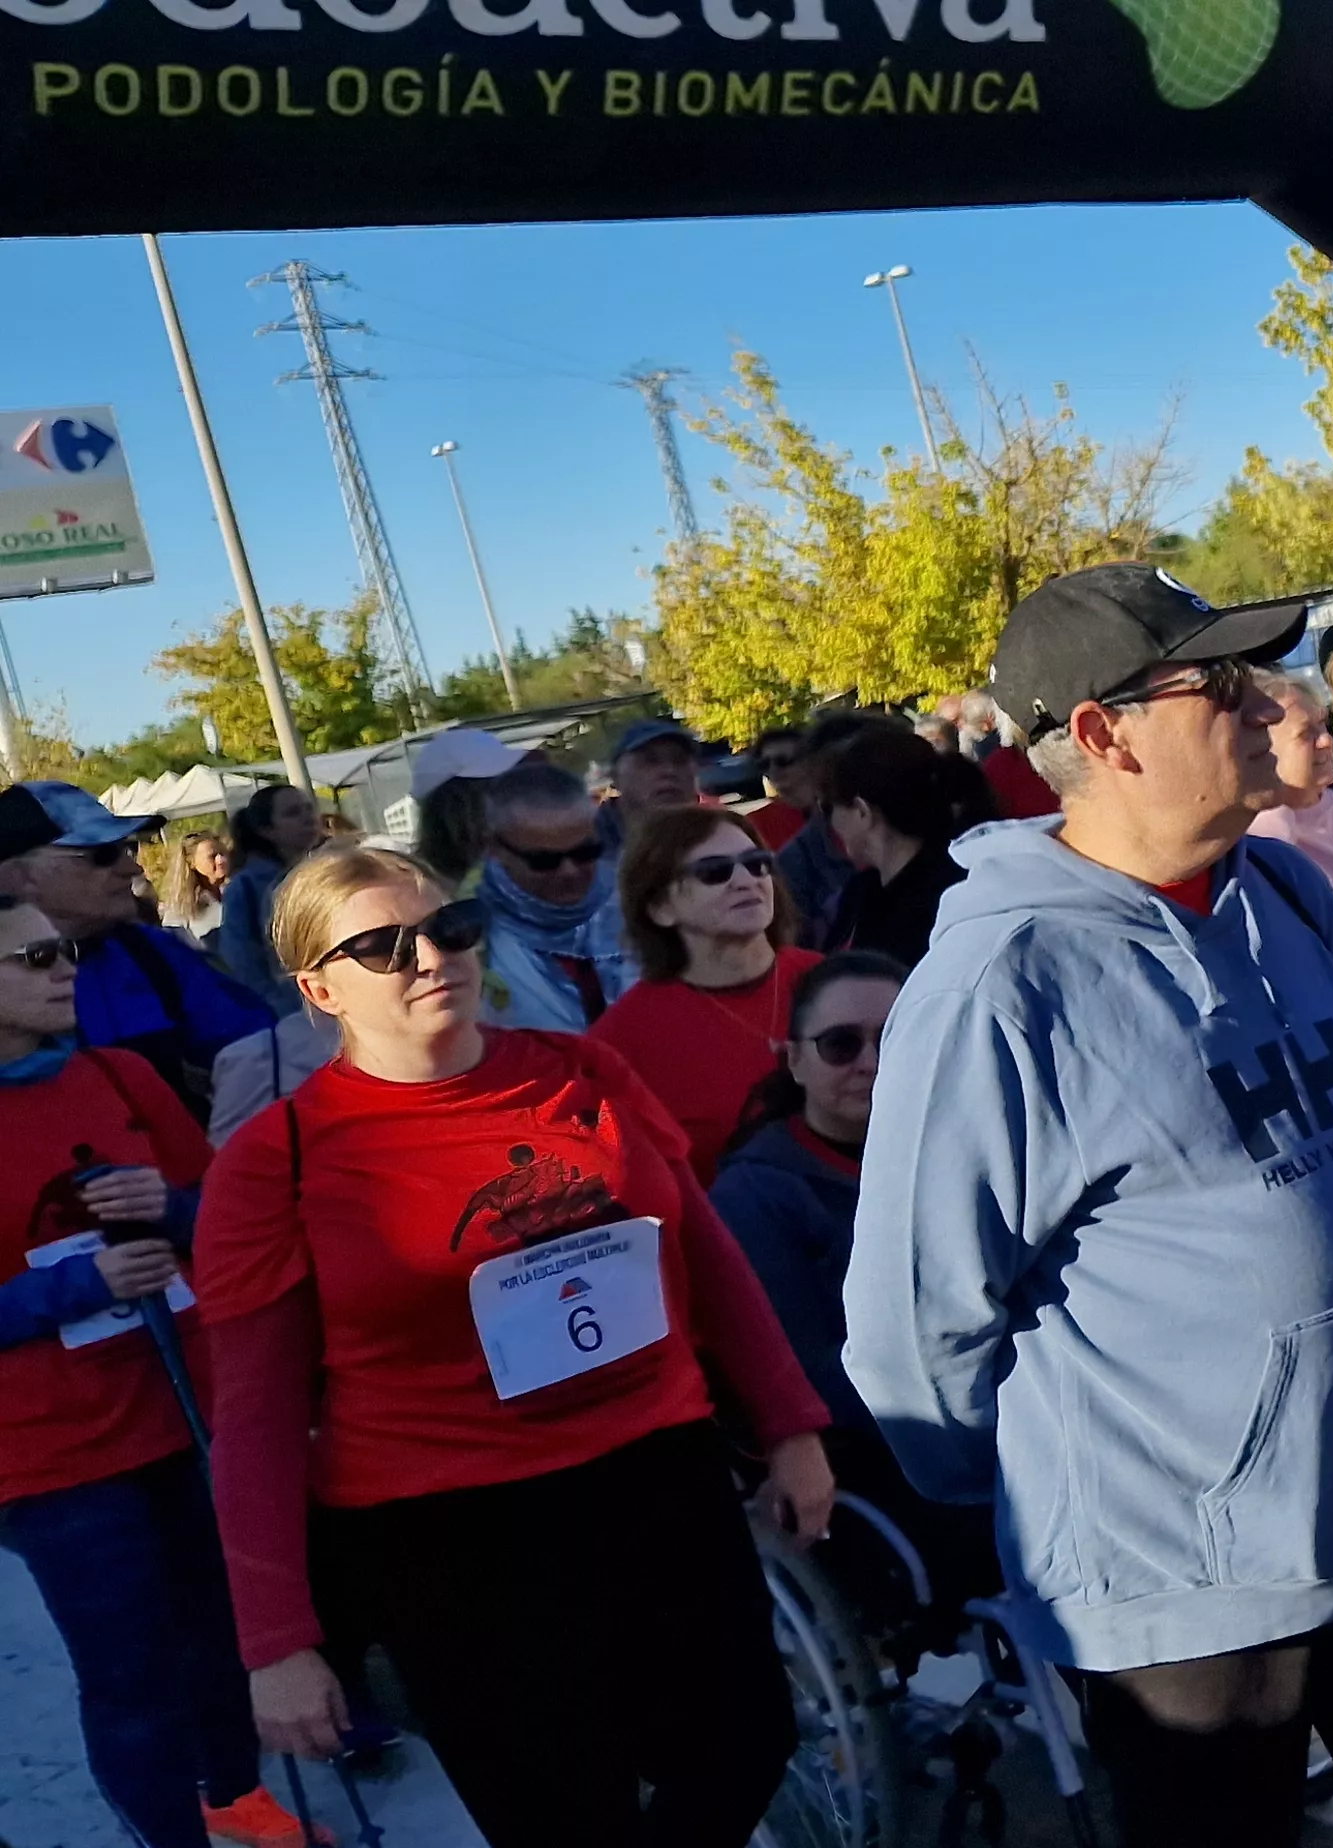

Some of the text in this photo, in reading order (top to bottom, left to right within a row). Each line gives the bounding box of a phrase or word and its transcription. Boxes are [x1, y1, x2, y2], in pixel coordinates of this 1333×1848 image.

[33, 53, 1040, 117] PODOLOGÍA Y BIOMECÁNICA
[1, 530, 54, 550] OSO
[1261, 1149, 1325, 1192] HELLY
[567, 1305, 604, 1353] 6
